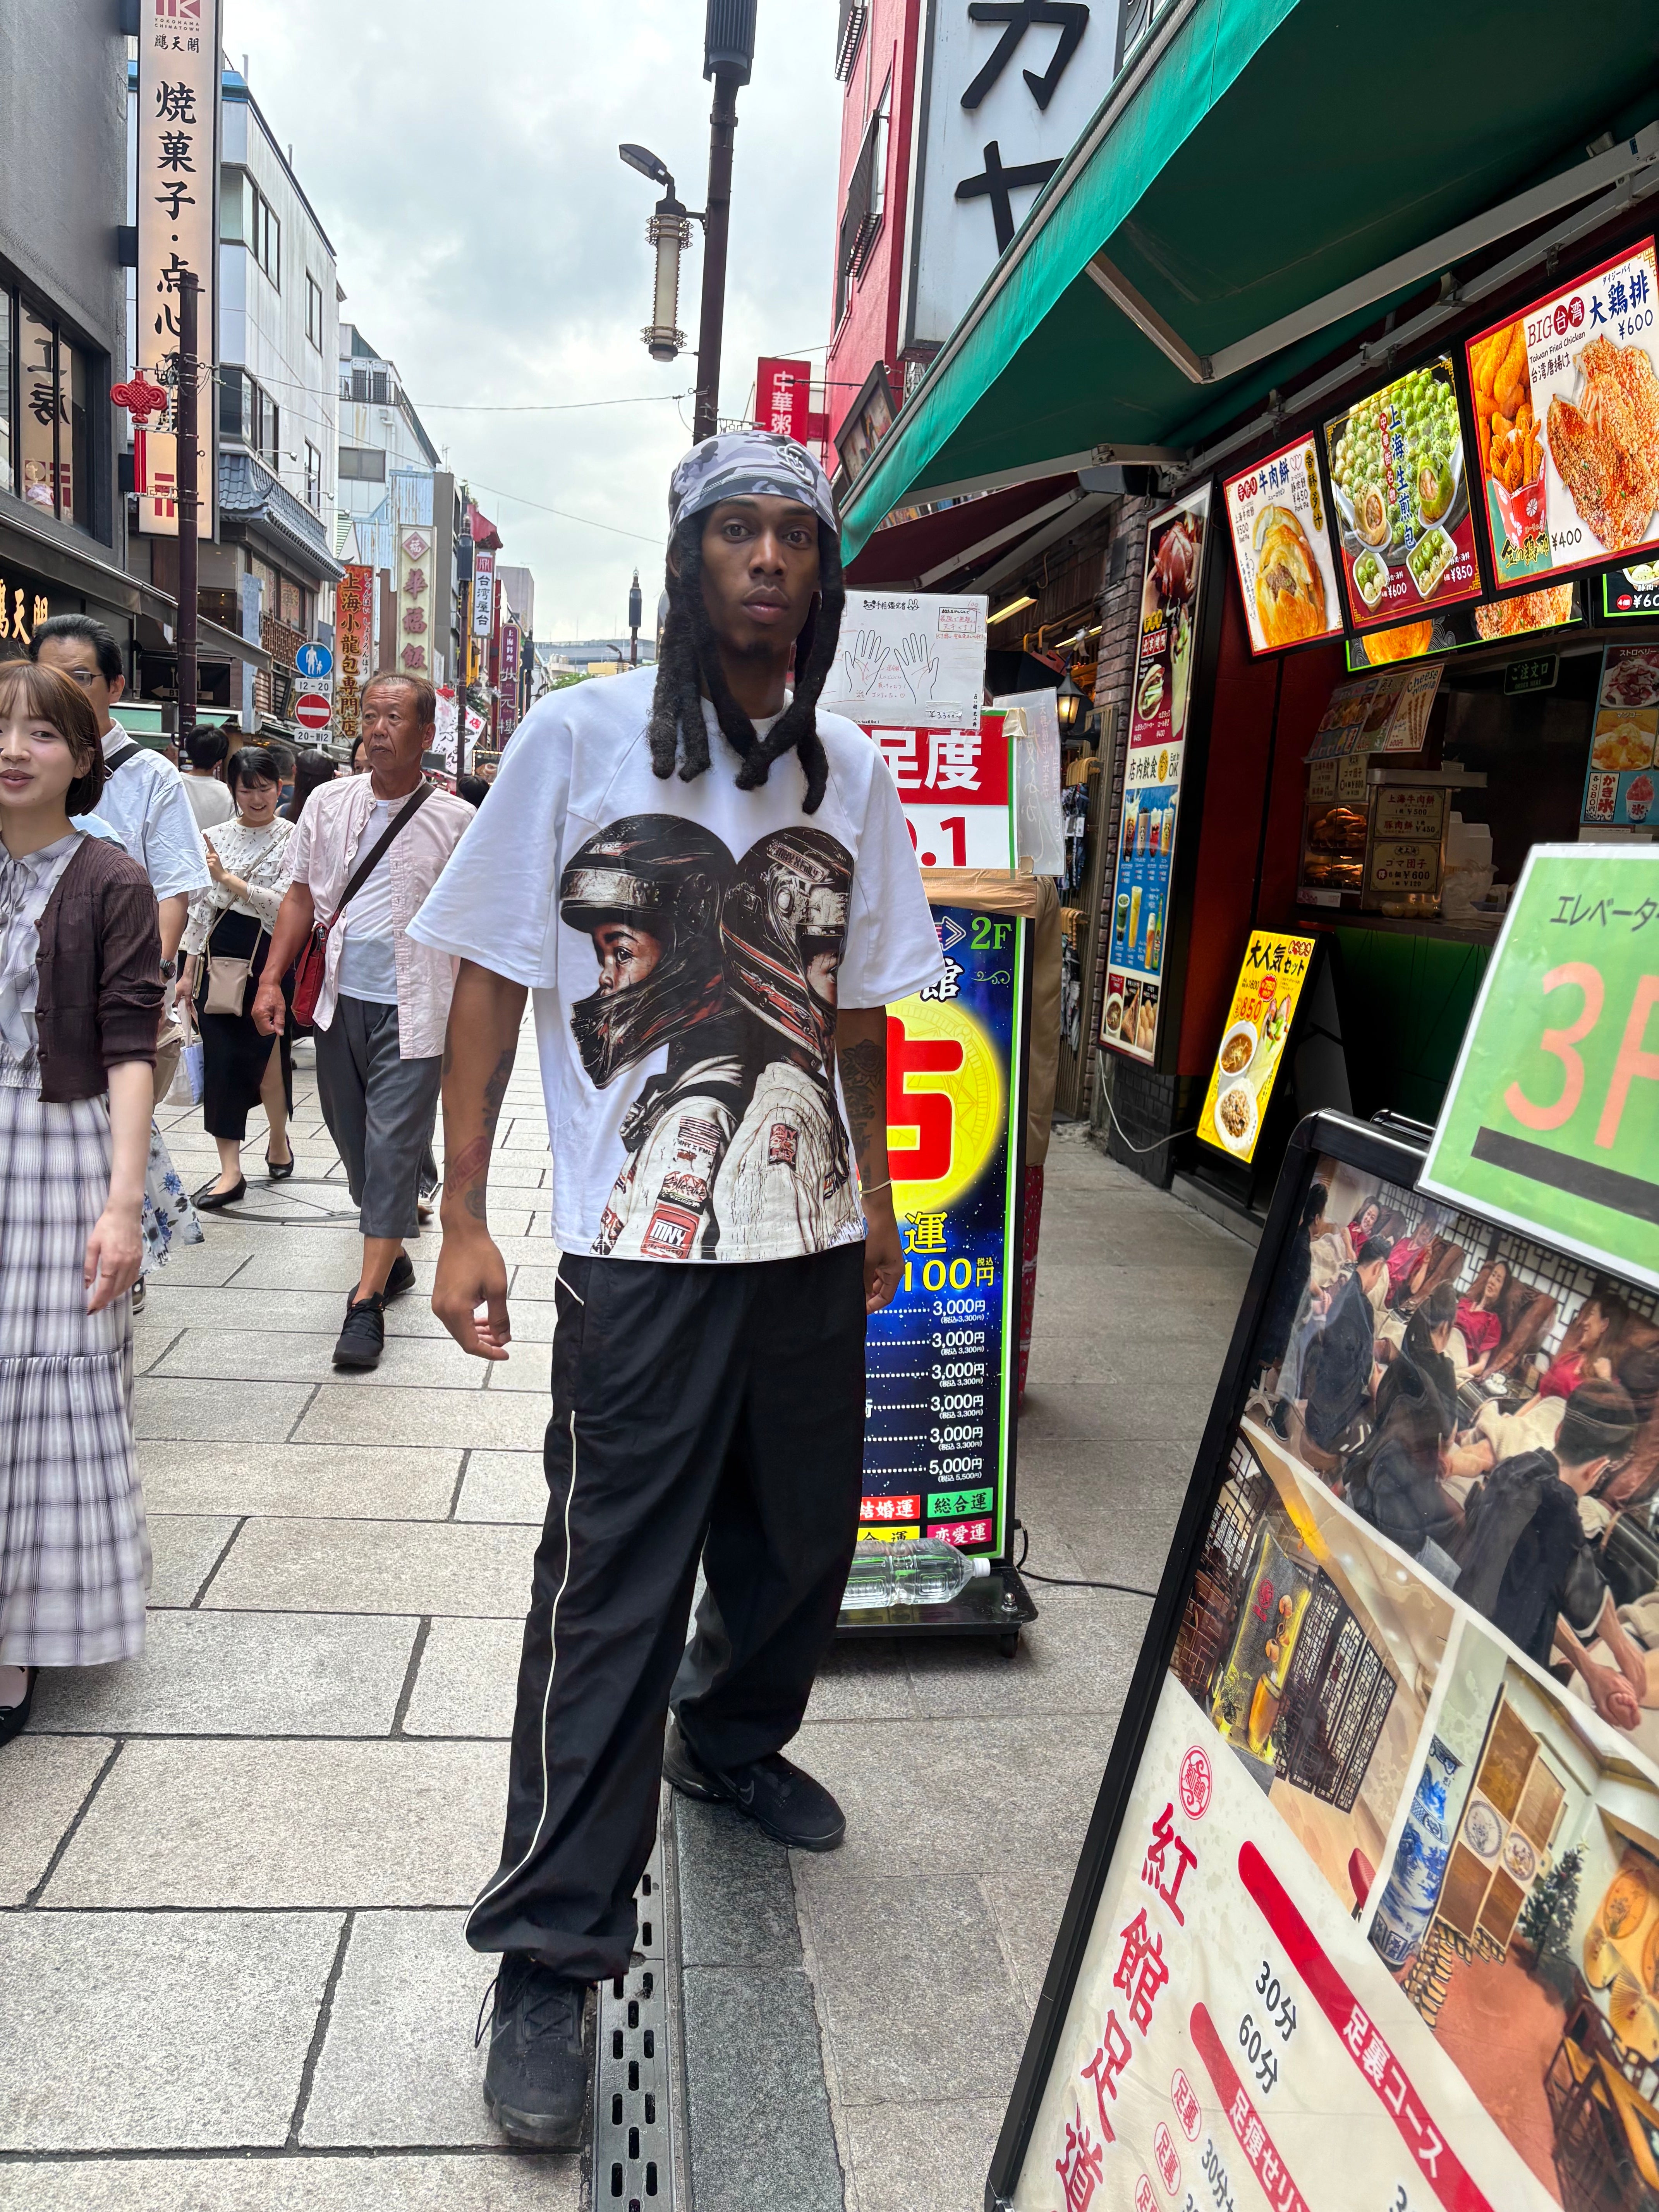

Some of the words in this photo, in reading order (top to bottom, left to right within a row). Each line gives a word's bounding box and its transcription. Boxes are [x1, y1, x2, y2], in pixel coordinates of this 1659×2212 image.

[155, 18, 199, 26] YOKOHAMA
[155, 23, 199, 31] CHINATOWN
[1527, 314, 1553, 348] BIG
[1555, 300, 1582, 331] 台湾
[1589, 269, 1650, 330] 大鶏排
[1618, 309, 1653, 340] ¥600
[1530, 349, 1549, 364] Taiwan
[1549, 341, 1563, 355] Fried
[1563, 331, 1586, 347] Chicken
[1531, 352, 1571, 384] 台湾唐揚げ
[771, 370, 793, 435] 中華粥
[1379, 413, 1396, 504] 中華街名物
[1259, 457, 1290, 495] 牛肉餅
[1292, 489, 1308, 505] ¥450
[1551, 528, 1582, 551] ¥400
[1451, 564, 1473, 582] ¥850
[476, 575, 491, 626] 台湾屋台
[1387, 582, 1407, 599] ¥600
[400, 568, 428, 671] 華福飯
[1620, 649, 1657, 657] ストロベリー
[1511, 662, 1549, 681] ご注文口
[299, 682, 329, 692] 12-20
[1128, 755, 1157, 781] 店内飲食
[1169, 761, 1178, 778] OK
[1388, 795, 1435, 804] 上海牛肉餅
[1598, 775, 1615, 813] かき氷
[1632, 804, 1644, 814] 氷
[1384, 820, 1413, 830] 豚肉餅
[906, 816, 967, 867] .1
[1386, 858, 1427, 869] ゴマ団子
[1403, 871, 1430, 879] ¥600
[1550, 894, 1659, 932] エレベータ
[970, 916, 1012, 950] 2F
[699, 1147, 716, 1157] FMLY
[649, 1221, 687, 1247] MNY
[903, 1211, 948, 1255] 運
[977, 1257, 993, 1266] 税込
[933, 1298, 986, 1316] 3,000円
[932, 1330, 985, 1349] 3,000円
[931, 1362, 984, 1381] 3,000円
[930, 1394, 984, 1412] 3,000円
[929, 1425, 983, 1444] 3,000円
[929, 1457, 982, 1475] 5,000円
[860, 1499, 914, 1519] 結婚運
[934, 1492, 987, 1514] 総合運
[935, 1522, 986, 1544] 恋愛運
[1055, 1802, 1198, 2212] 紅館足道
[1255, 1960, 1297, 2042] 30分
[1239, 2014, 1278, 2094] 60分
[1342, 2004, 1443, 2178] 足裏コース
[1173, 2075, 1199, 2135] 足裏
[1156, 2129, 1178, 2189] 足裏
